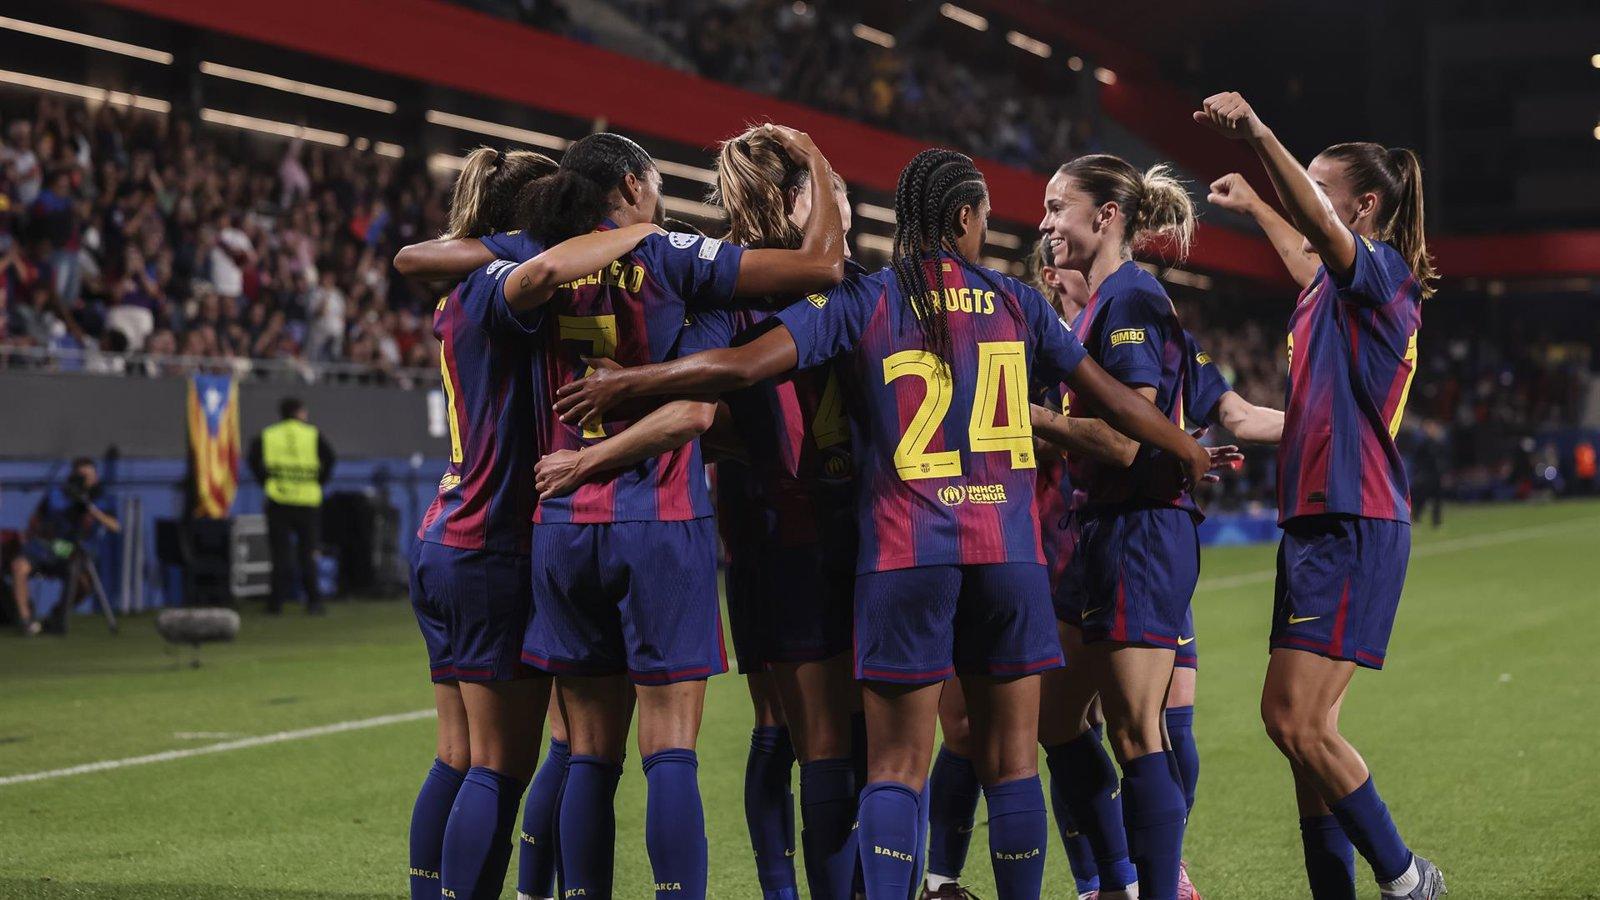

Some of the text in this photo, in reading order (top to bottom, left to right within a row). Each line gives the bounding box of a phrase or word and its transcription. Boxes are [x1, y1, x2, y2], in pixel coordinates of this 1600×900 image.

[910, 288, 995, 320] RUGTS
[1111, 331, 1144, 344] BIMBO
[883, 341, 1037, 481] 24
[966, 484, 1004, 493] UNHCR
[968, 492, 1006, 501] ACNUR
